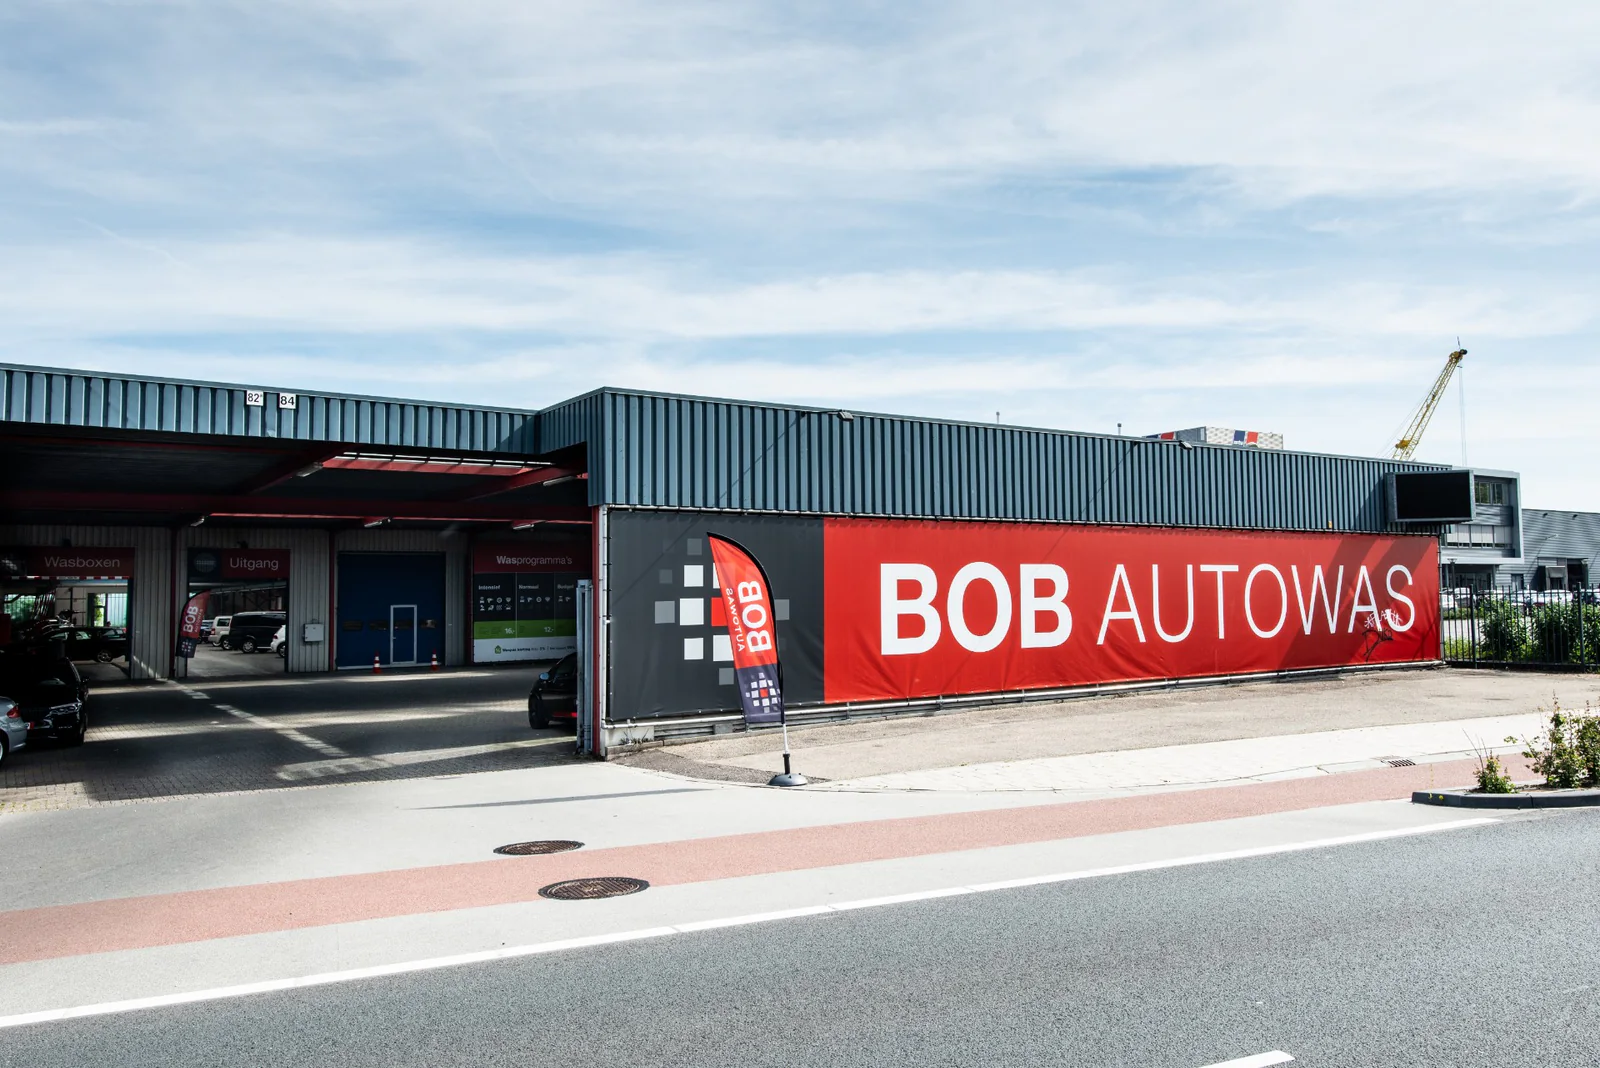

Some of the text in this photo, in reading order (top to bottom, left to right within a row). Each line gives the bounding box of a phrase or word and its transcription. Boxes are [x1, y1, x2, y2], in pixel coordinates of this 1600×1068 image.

[280, 395, 295, 406] 84
[44, 556, 121, 568] Wasboxen
[229, 557, 279, 571] Uitgang
[496, 555, 573, 567] Wasprogramma's
[880, 562, 1416, 656] BOB AUTOWAS
[183, 605, 199, 633] BOB
